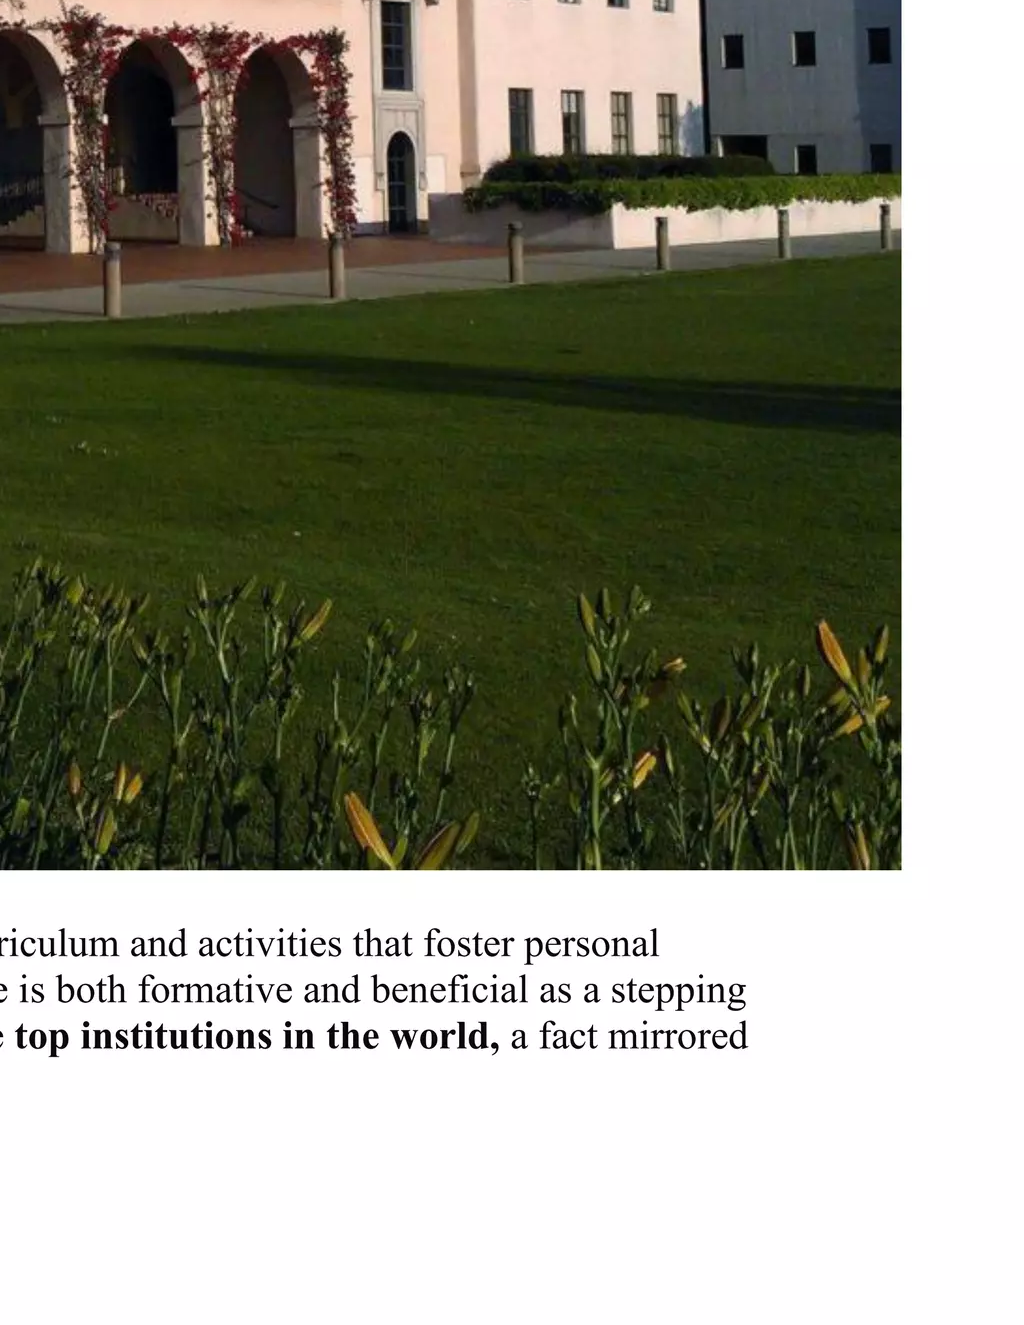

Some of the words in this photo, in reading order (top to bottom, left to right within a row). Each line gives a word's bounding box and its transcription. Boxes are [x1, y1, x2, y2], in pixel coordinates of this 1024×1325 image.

[131, 928, 187, 957] and
[199, 928, 341, 957] activities
[353, 928, 412, 957] that
[424, 928, 515, 957] foster
[524, 928, 659, 965] personal
[20, 974, 44, 1003] is
[56, 974, 127, 1003] both
[139, 974, 292, 1003] formative
[304, 974, 361, 1003] and
[371, 974, 528, 1003] beneficial
[540, 984, 571, 1003] as
[584, 984, 601, 1003] a
[612, 974, 746, 1011] stepping
[15, 1023, 69, 1057] top
[81, 1021, 271, 1049] institutions
[283, 1021, 314, 1049] in
[327, 1022, 379, 1049] the
[390, 1022, 499, 1055] world,
[512, 1030, 528, 1049] a
[540, 1020, 598, 1049] fact
[608, 1020, 748, 1049] mirrored
